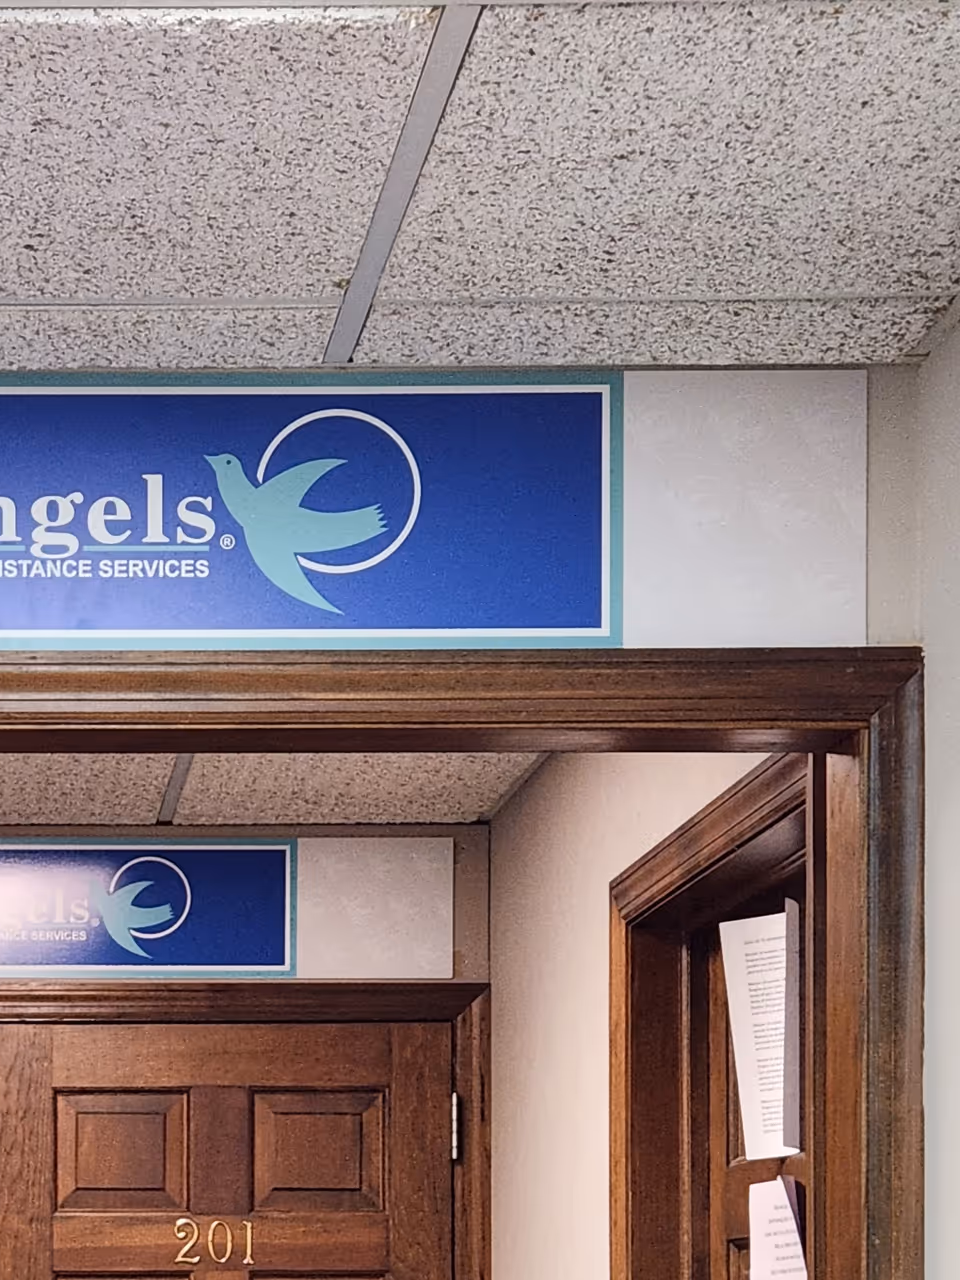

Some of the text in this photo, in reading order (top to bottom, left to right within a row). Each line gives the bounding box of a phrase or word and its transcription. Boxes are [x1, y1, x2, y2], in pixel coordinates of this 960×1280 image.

[98, 559, 210, 578] SERVICES
[31, 930, 88, 941] SERVICES
[174, 1217, 255, 1265] 201
